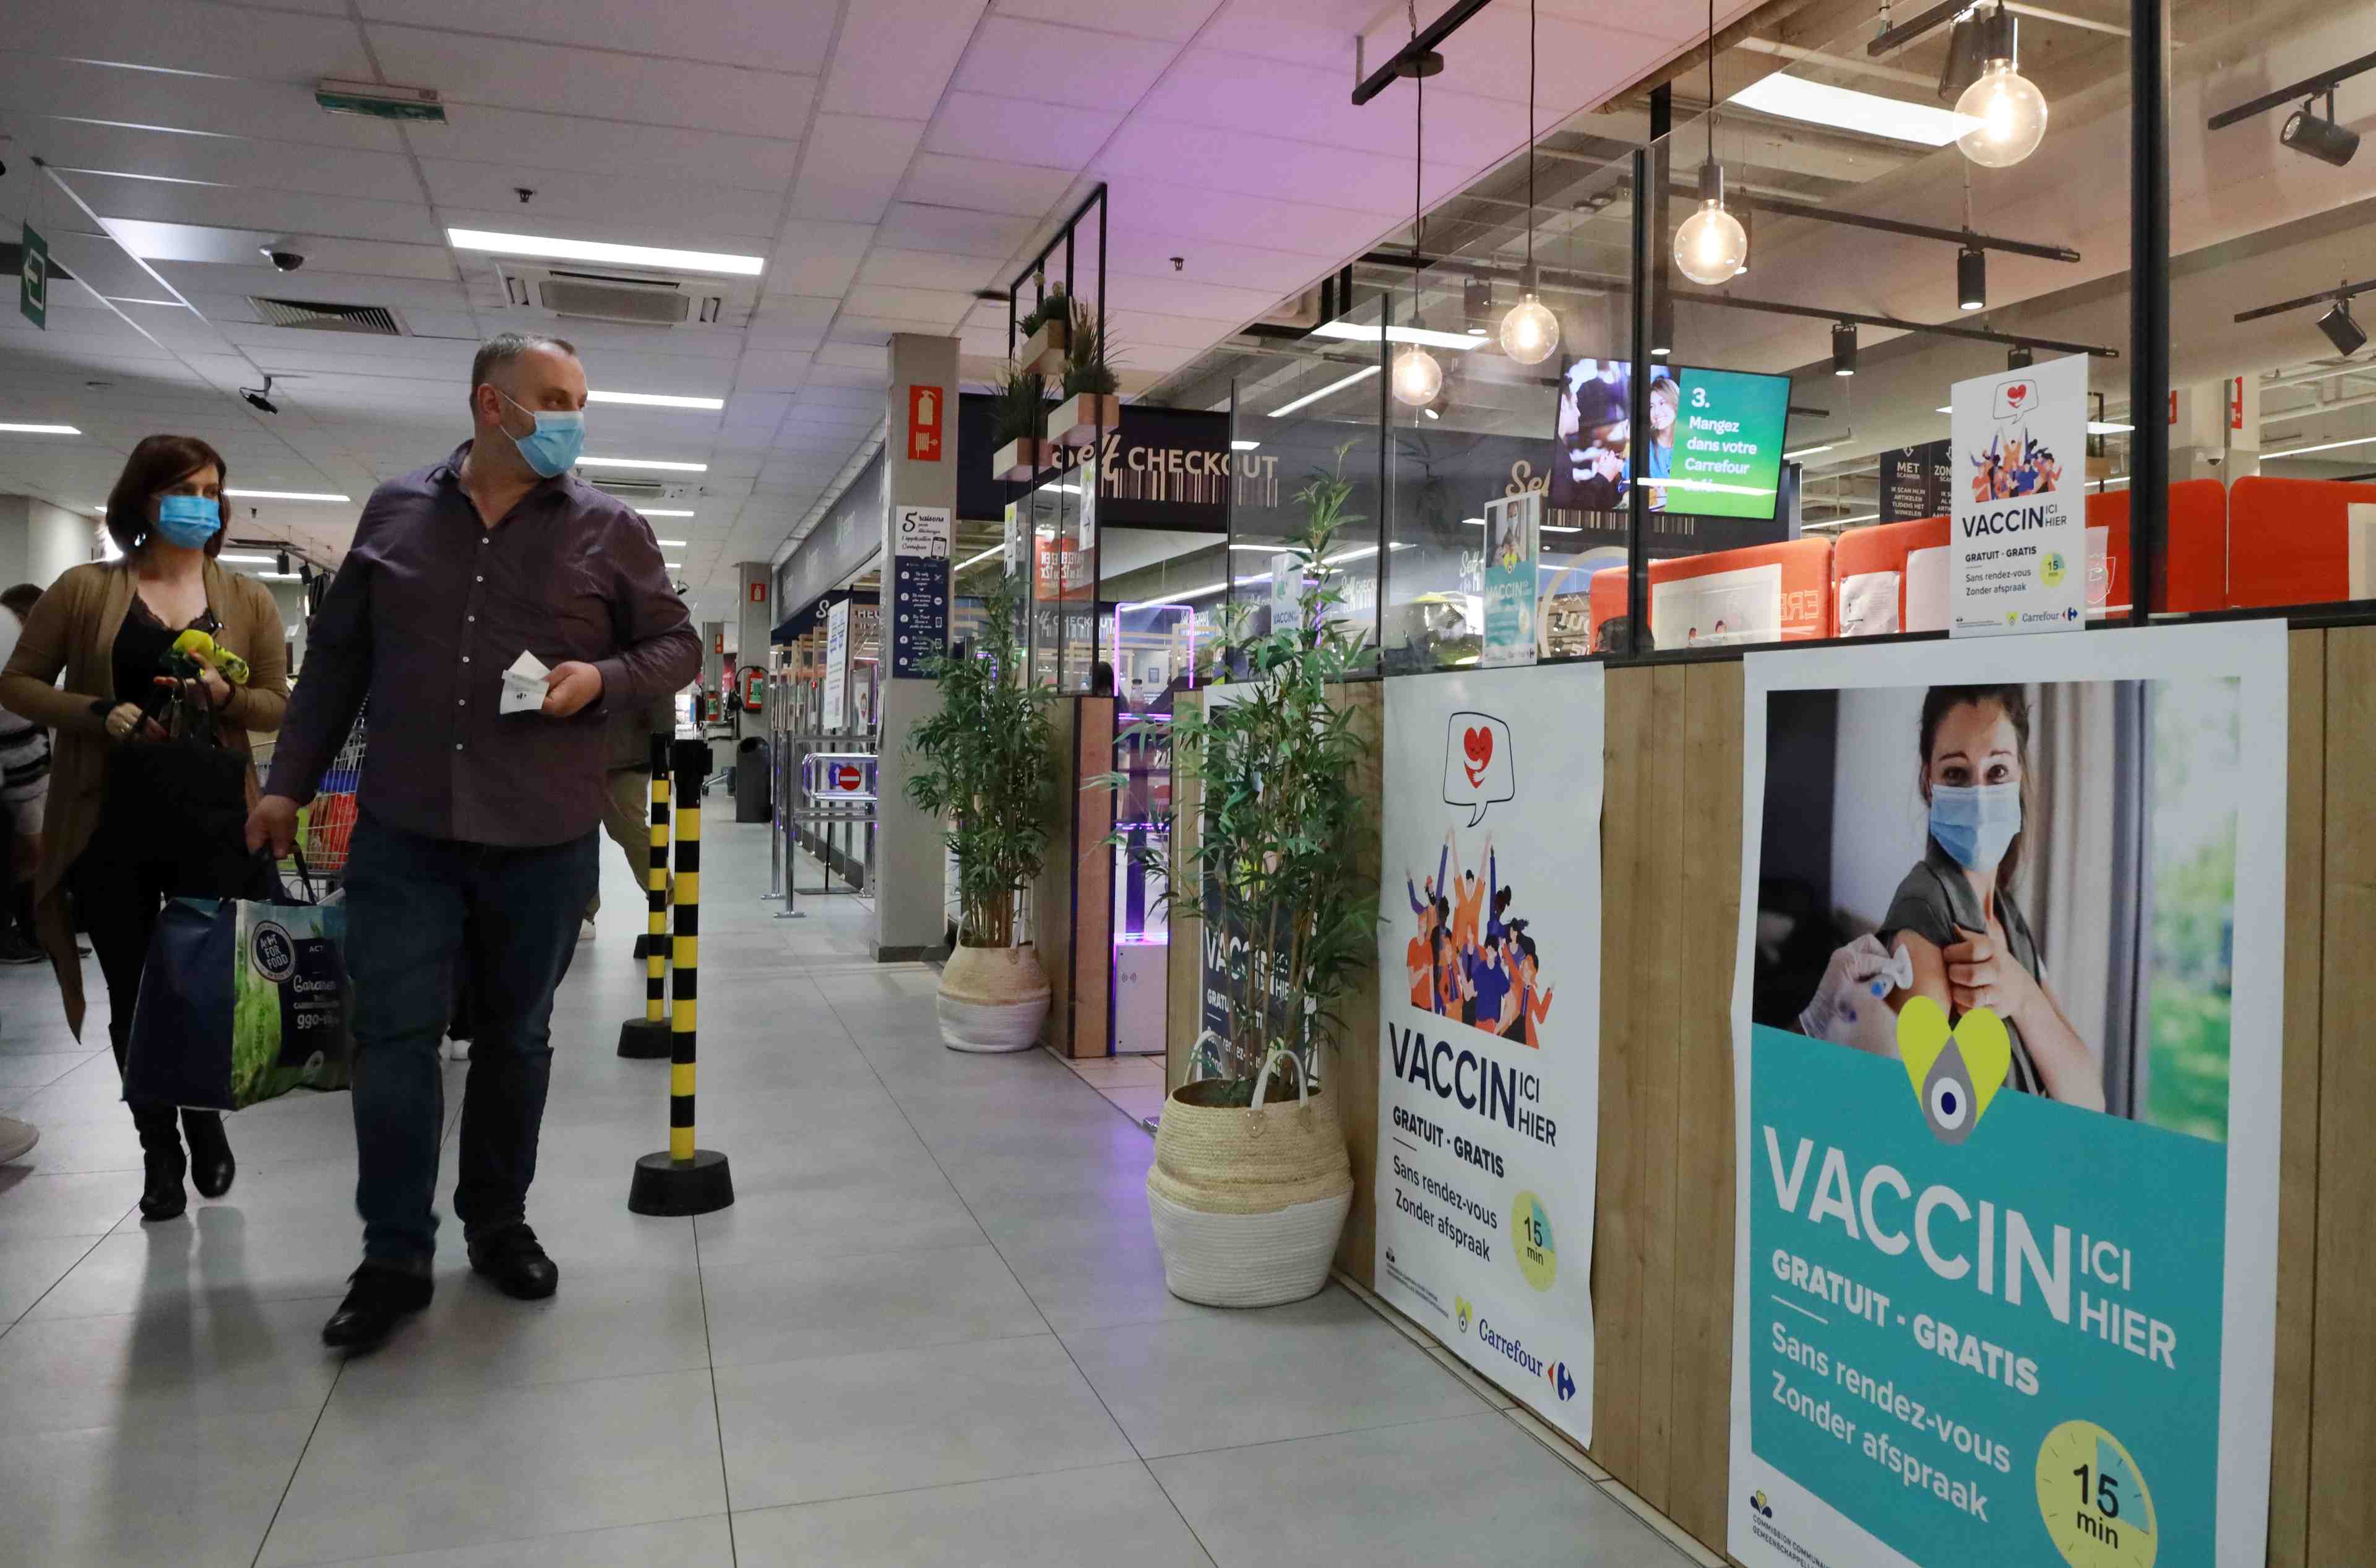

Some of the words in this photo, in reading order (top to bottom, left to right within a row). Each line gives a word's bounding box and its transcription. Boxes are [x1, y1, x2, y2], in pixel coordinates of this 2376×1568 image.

[1691, 387, 1710, 408] 3.
[1689, 415, 1740, 434] Mangez
[1687, 437, 1720, 452] dans
[1723, 442, 1758, 455] votre
[1684, 457, 1750, 475] Carrefour
[1896, 461, 1920, 473] MET
[902, 511, 917, 532] 5
[1895, 509, 1922, 517] WINKELEN
[1962, 506, 2044, 538] VACCIN
[2046, 504, 2058, 514] ICI
[2046, 515, 2067, 527] HIER
[1965, 550, 1999, 562] GRATUIT
[2006, 546, 2037, 558] GRATIS
[2047, 560, 2059, 571] 15
[1966, 573, 1984, 582] Sans
[1985, 569, 2031, 580] rendez-vous
[1966, 586, 1992, 596] Zonder
[1994, 582, 2026, 595] afspraak
[2022, 611, 2060, 622] Carrefour
[265, 945, 282, 958] FOR
[267, 954, 288, 970] FOOD
[1388, 1022, 1517, 1129] VACCIN
[1519, 1072, 1539, 1103] ICI
[1393, 1105, 1444, 1148] GRATUIT
[1453, 1136, 1505, 1178] GRATIS
[1518, 1108, 1556, 1147] HIER
[1393, 1155, 1420, 1186] Sans
[1423, 1175, 1497, 1230] rendez-vous
[1395, 1188, 1434, 1228] Zonder
[1438, 1216, 1490, 1263] afspraak
[1524, 1216, 1543, 1248] 15
[1763, 1124, 2071, 1325] VACCIN
[1526, 1244, 1544, 1266] min
[2080, 1234, 2132, 1291] ICI
[1771, 1249, 1890, 1327] GRATUIT
[1913, 1313, 2040, 1397] GRATIS
[2080, 1290, 2177, 1371] HIER
[1479, 1318, 1544, 1377] Carrefour
[1771, 1321, 1830, 1377] Sans
[1836, 1360, 2011, 1474] rendez-vous
[1771, 1371, 1857, 1445] Zonder
[1862, 1430, 1990, 1523] afspraak
[2073, 1463, 2119, 1518] 15
[1752, 1514, 1791, 1547] COMMISSION
[2077, 1510, 2119, 1549] min
